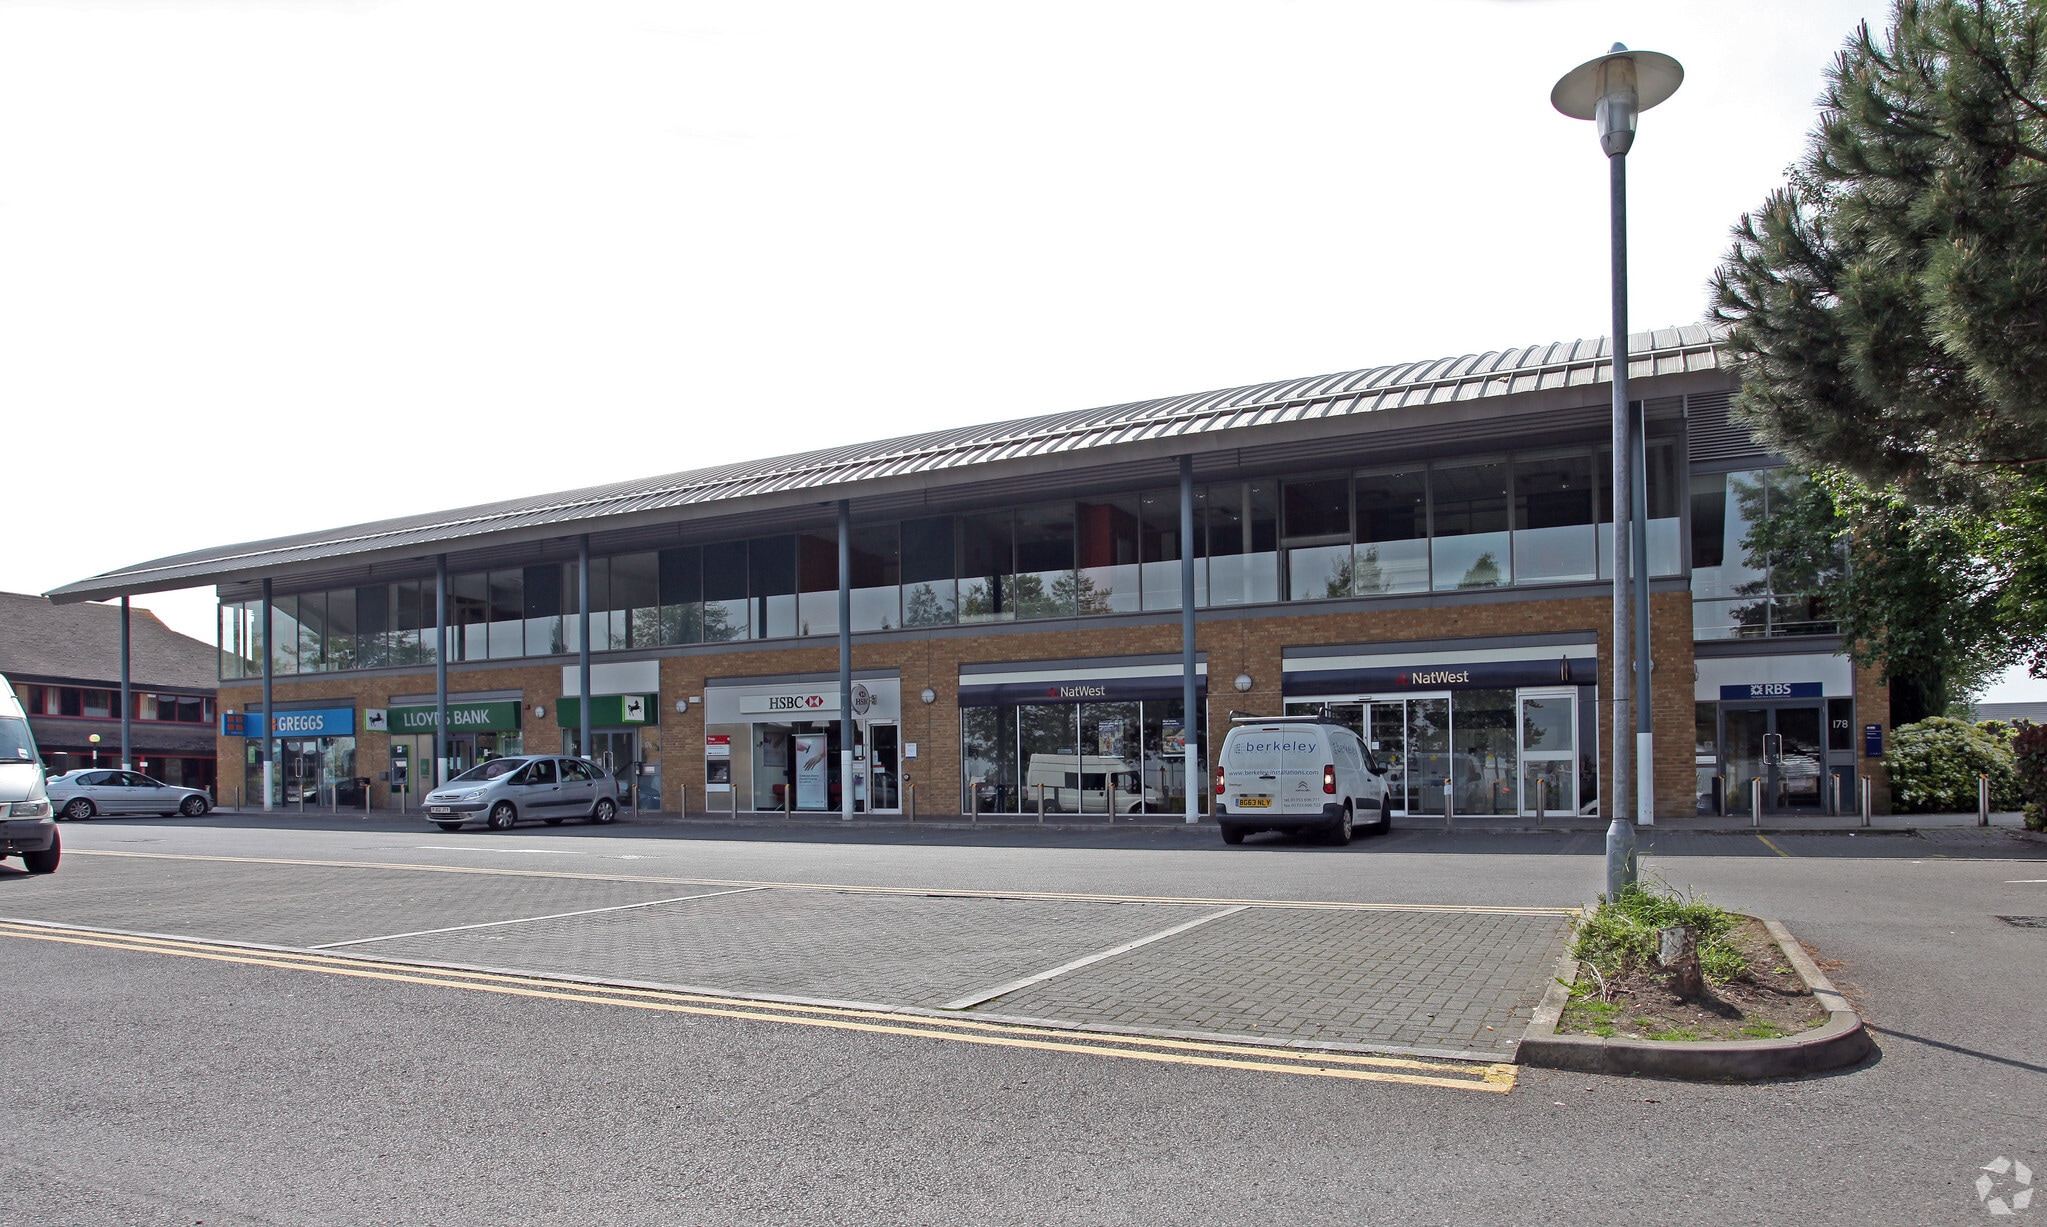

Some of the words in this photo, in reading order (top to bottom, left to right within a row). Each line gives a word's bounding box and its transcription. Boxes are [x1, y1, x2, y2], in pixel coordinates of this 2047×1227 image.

[1412, 670, 1469, 684] NatWest
[1060, 685, 1105, 697] NatWest
[1765, 683, 1791, 695] RBS
[769, 696, 804, 710] HSBC
[278, 715, 324, 731] GREGGS
[454, 709, 490, 725] BANK
[1833, 719, 1848, 728] 178
[1246, 741, 1317, 753] berkeley
